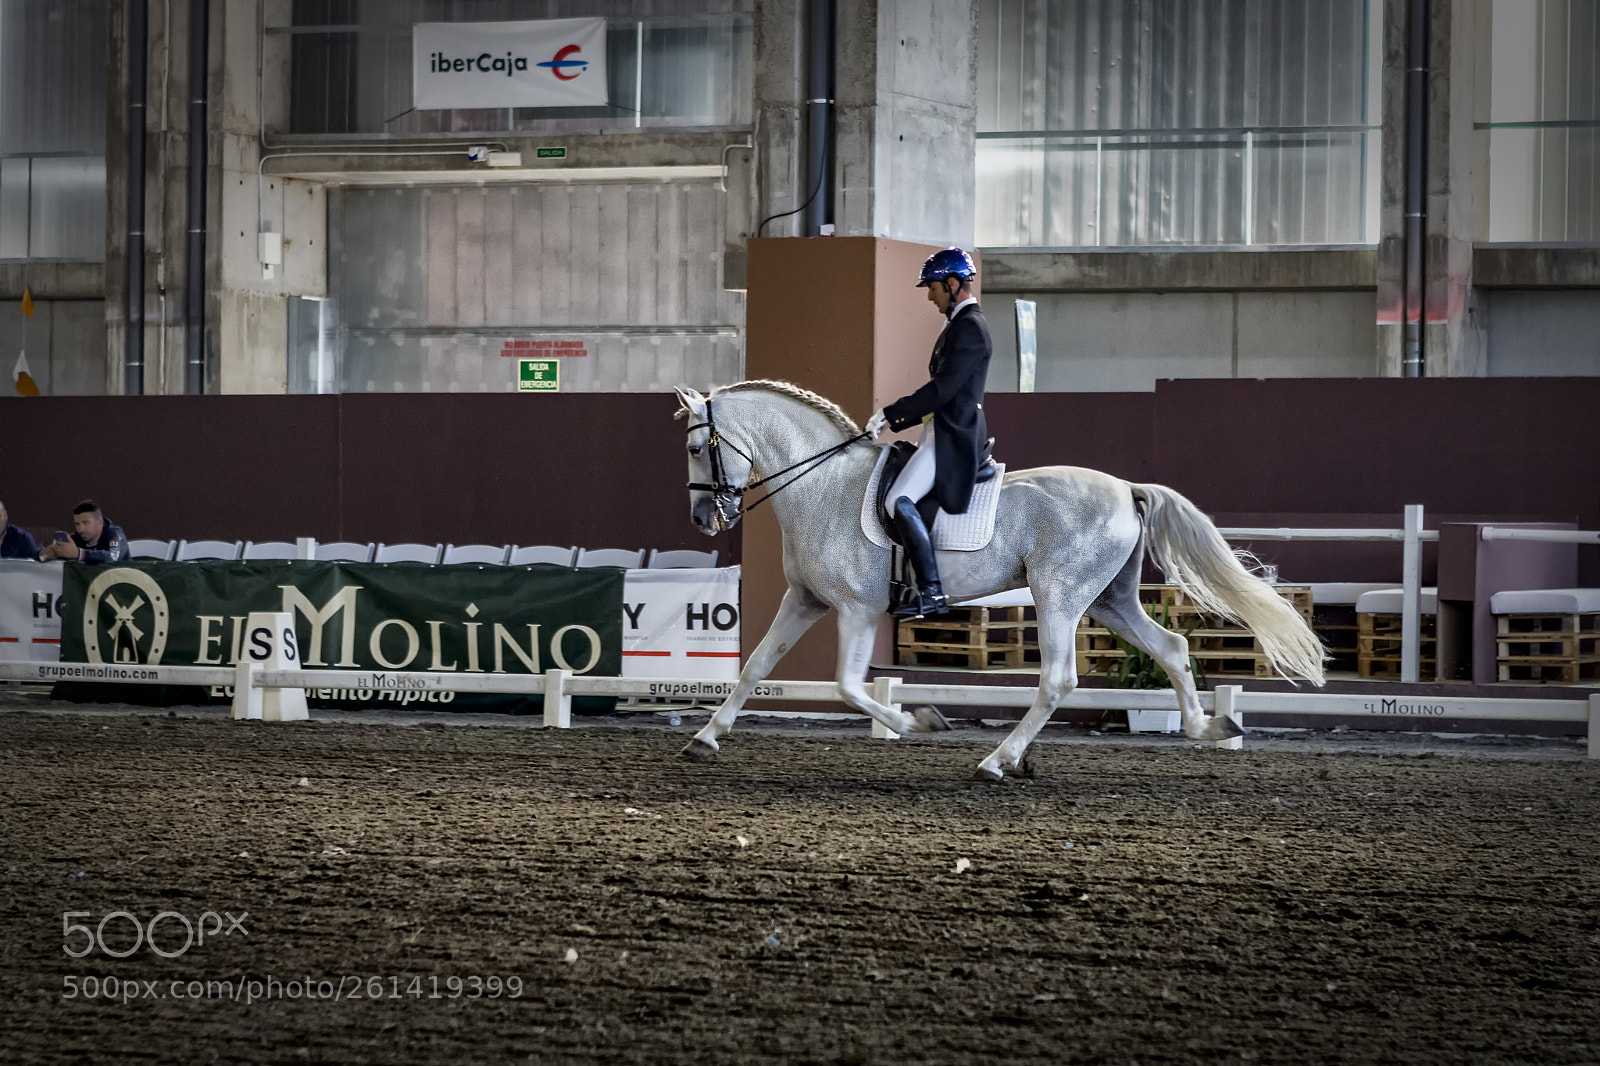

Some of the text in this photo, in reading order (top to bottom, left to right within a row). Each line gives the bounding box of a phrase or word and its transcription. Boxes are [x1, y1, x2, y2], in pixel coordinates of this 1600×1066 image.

[430, 52, 528, 77] iberCaja
[528, 363, 549, 371] SALIDA
[249, 627, 274, 661] S
[283, 627, 296, 661] S
[38, 664, 159, 680] grupoelmolino.com
[649, 681, 784, 696] grupoelmoli.com
[1381, 698, 1445, 716] MOLINO
